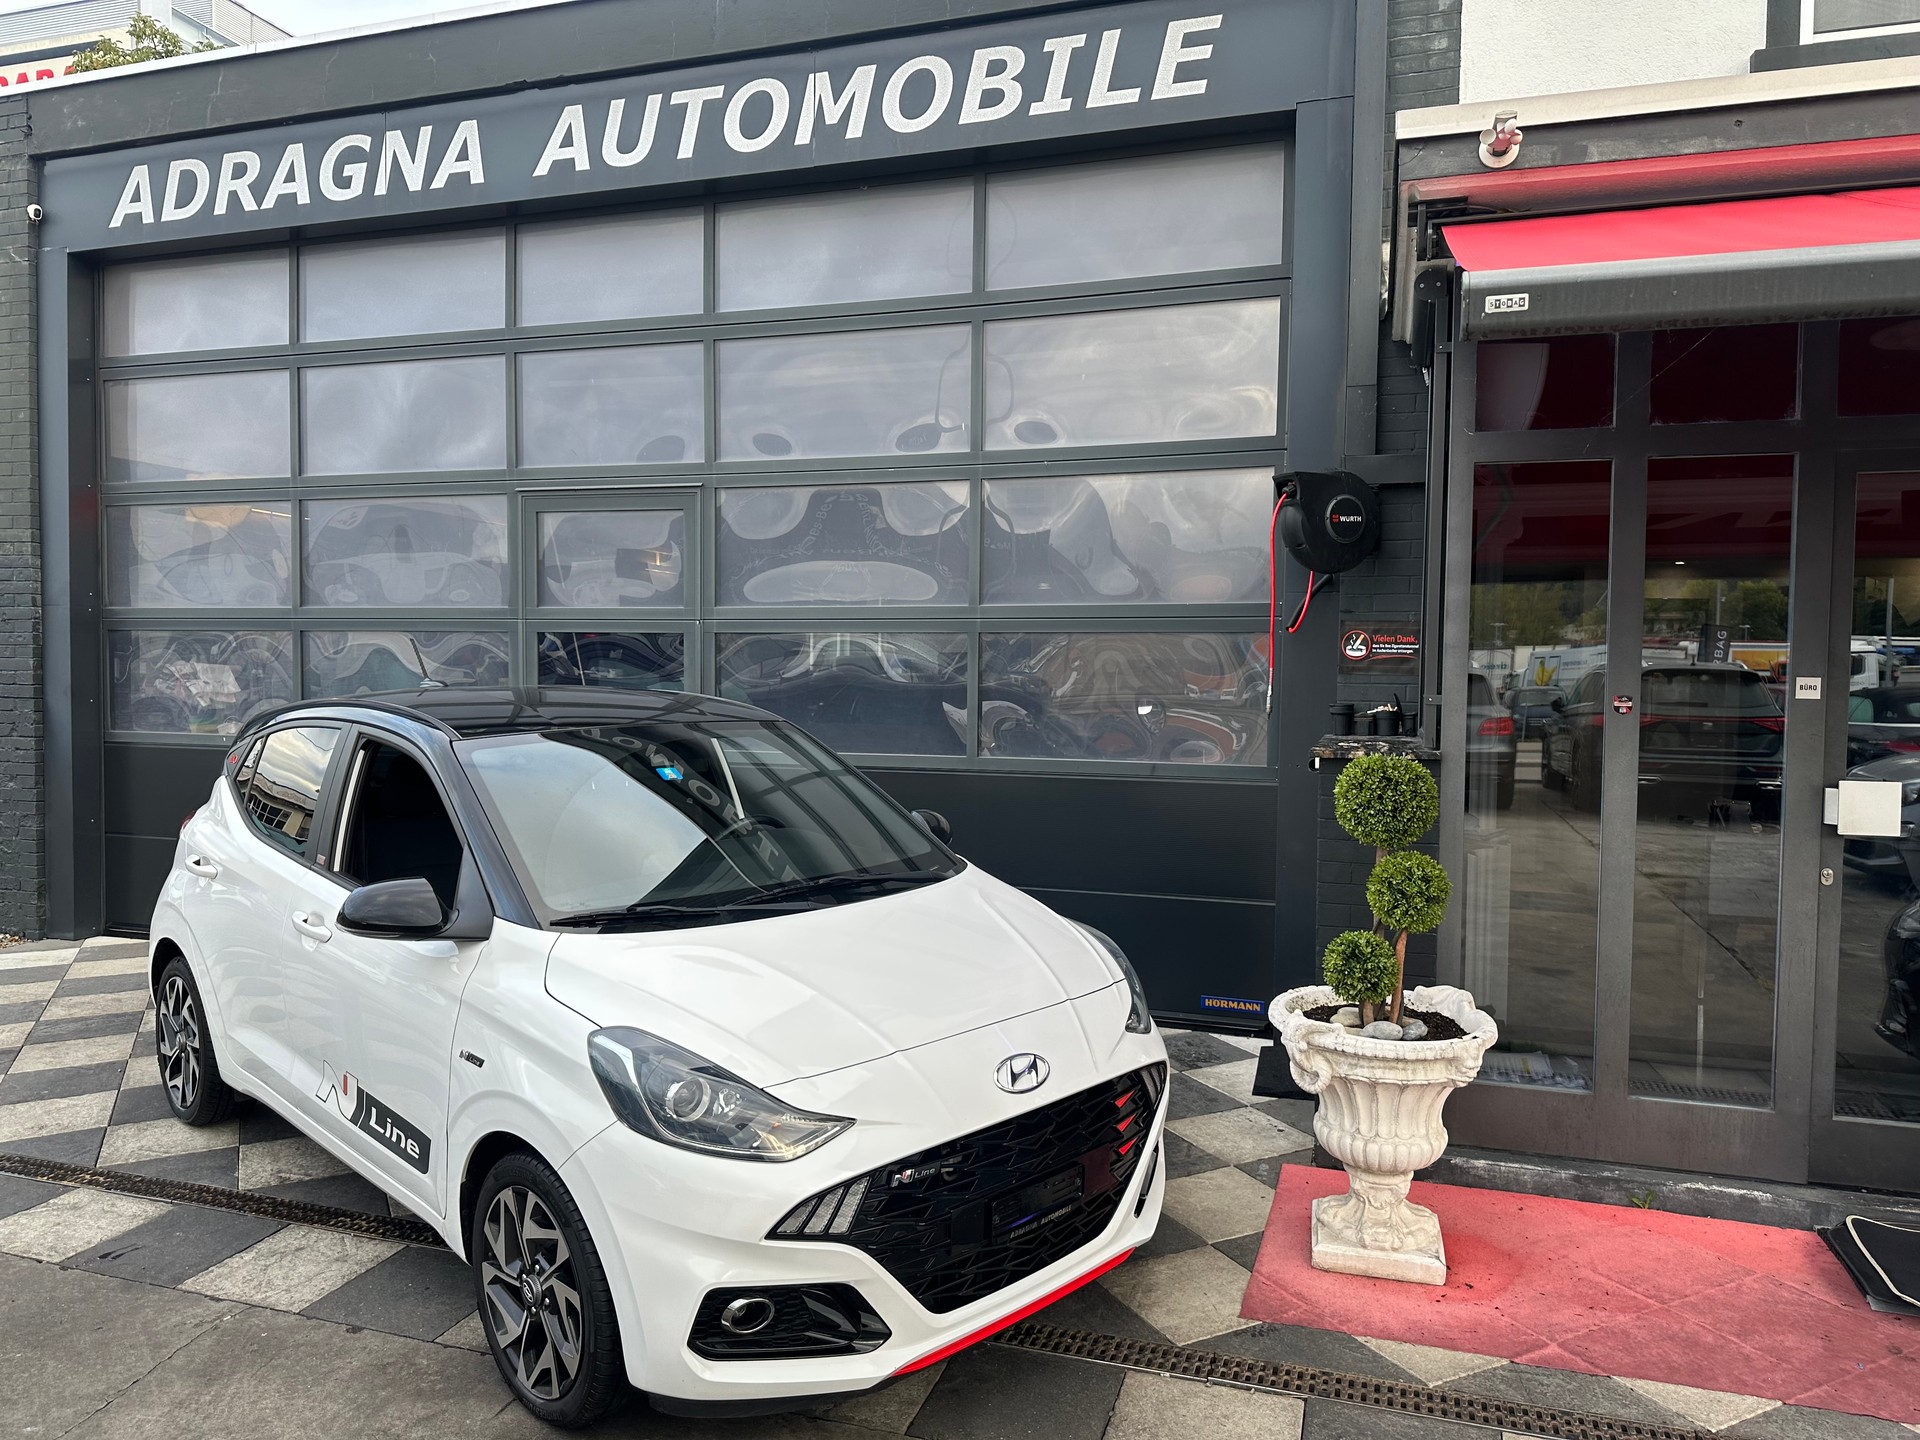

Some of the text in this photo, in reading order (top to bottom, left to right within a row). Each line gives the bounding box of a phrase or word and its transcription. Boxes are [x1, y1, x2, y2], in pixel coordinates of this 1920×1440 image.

[108, 14, 1223, 229] ADRAGNA AUTOMOBILE
[1397, 635, 1418, 643] Dank,
[369, 1106, 420, 1159] Line
